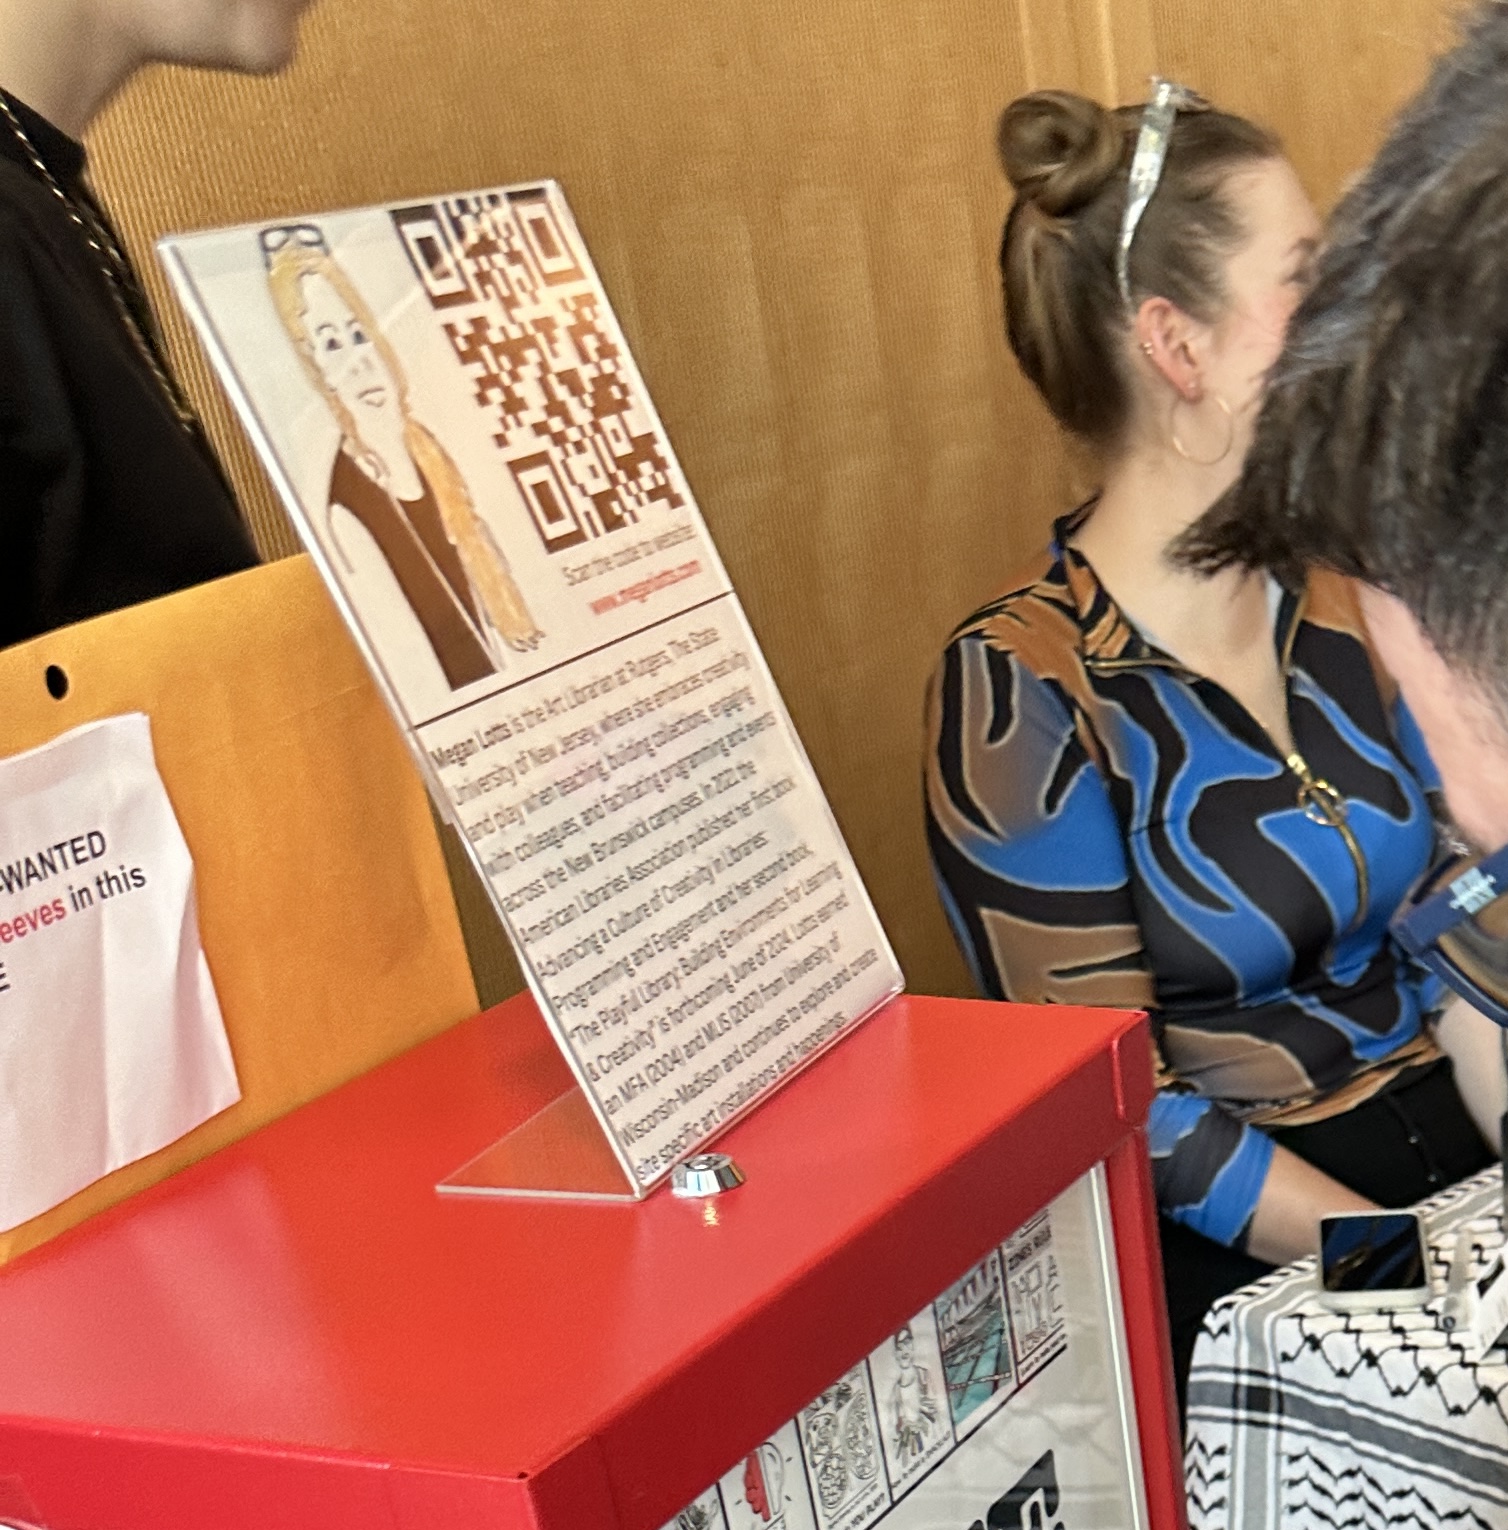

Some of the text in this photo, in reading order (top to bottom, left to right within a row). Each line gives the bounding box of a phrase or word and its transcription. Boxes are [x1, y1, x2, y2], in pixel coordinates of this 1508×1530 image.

[429, 736, 478, 769] Megan
[473, 720, 512, 749] Lotts
[519, 705, 546, 728] the
[67, 885, 94, 912] in
[97, 864, 146, 900] this
[541, 864, 569, 890] the
[562, 850, 594, 877] New
[604, 900, 652, 939] Culture
[648, 888, 665, 913] of
[517, 900, 580, 947] American
[598, 926, 611, 944] a
[629, 936, 655, 967] and
[603, 1092, 623, 1115] an
[617, 1069, 649, 1104] MFA
[682, 1028, 706, 1059] and
[720, 1042, 744, 1073] and
